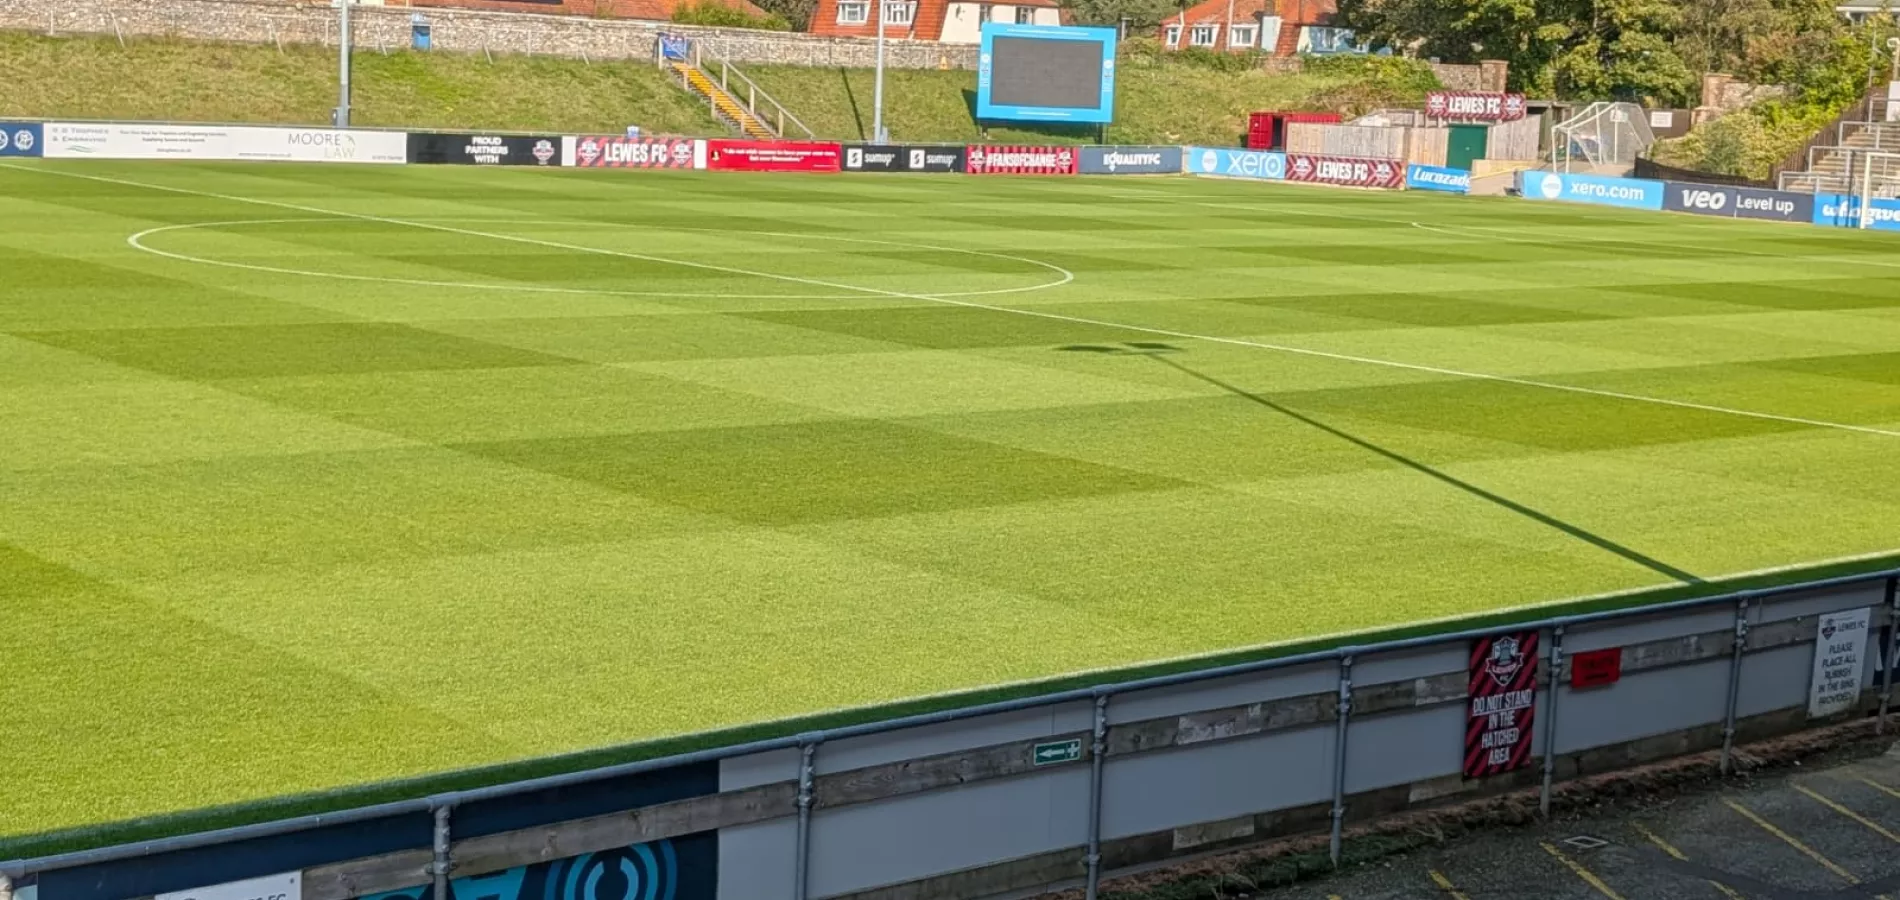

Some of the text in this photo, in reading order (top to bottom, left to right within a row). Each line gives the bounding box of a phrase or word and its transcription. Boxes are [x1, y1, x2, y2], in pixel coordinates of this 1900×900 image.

[1449, 96, 1501, 115] LEWES FC
[288, 133, 341, 146] MOORE
[472, 136, 502, 146] PROUD
[324, 147, 355, 159] LAW
[465, 145, 508, 155] PARTNERS
[475, 154, 499, 164] WITH
[604, 142, 667, 163] LEWES FC
[986, 152, 1057, 168] #FANSOFCHANGE
[1227, 152, 1281, 177] xero
[1316, 161, 1369, 181] LEWES FC
[1570, 180, 1645, 200] xero.com
[1682, 189, 1727, 210] veo
[1736, 194, 1794, 215] Level up
[1829, 642, 1853, 654] PLEASE
[1822, 656, 1843, 667] PLACE
[1473, 689, 1533, 713] DO NOT STAND
[1488, 710, 1515, 730] IN THE
[1482, 729, 1519, 748] HATCHED
[1488, 747, 1510, 766] AREA
